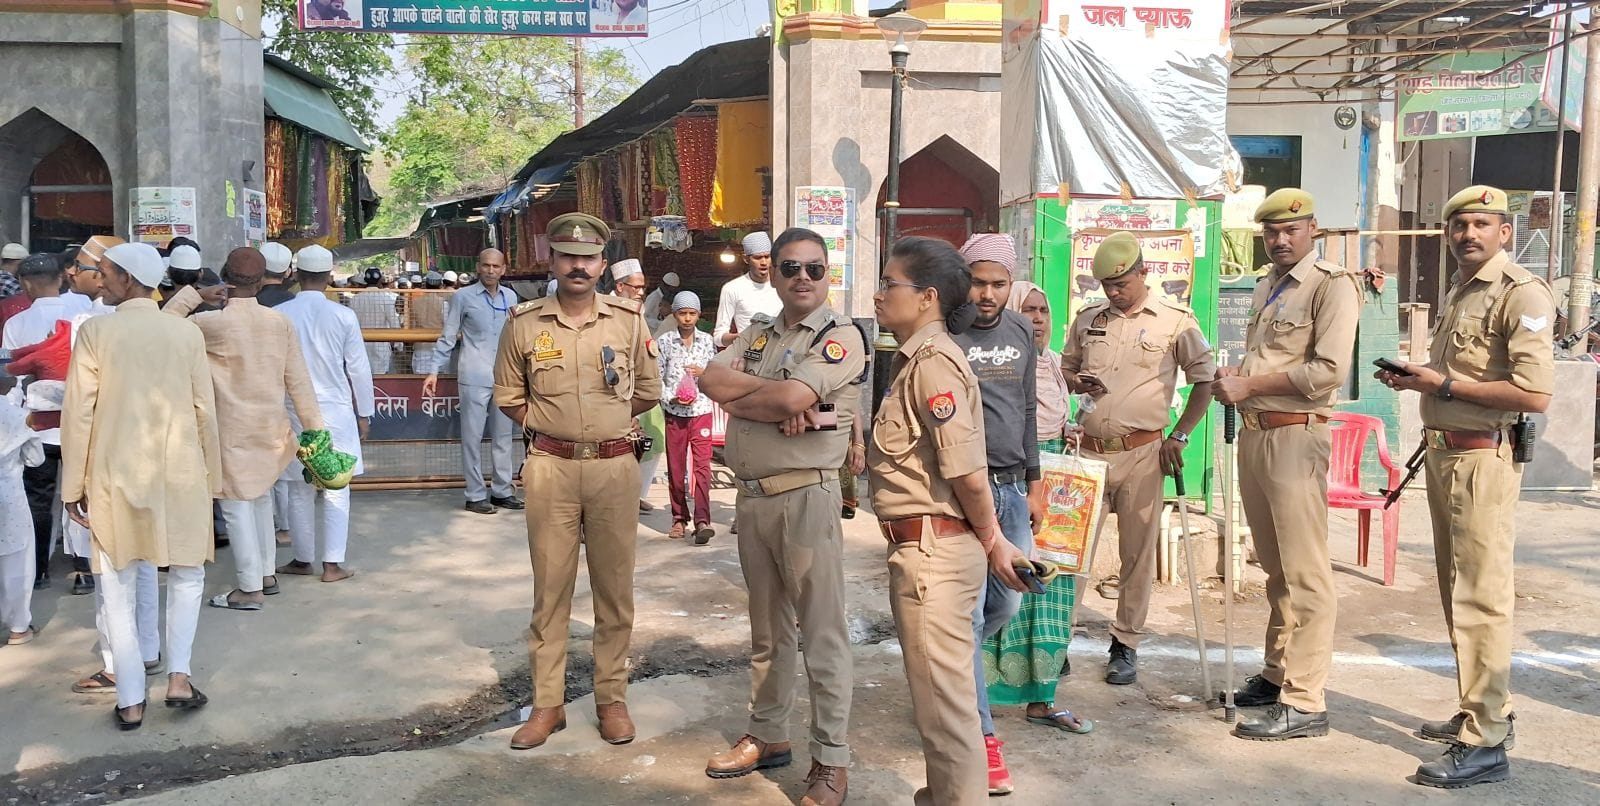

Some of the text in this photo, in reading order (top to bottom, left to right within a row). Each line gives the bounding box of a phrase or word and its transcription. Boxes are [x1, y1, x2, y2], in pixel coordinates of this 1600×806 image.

[392, 4, 418, 24] आपके
[469, 6, 481, 25] की
[484, 6, 498, 25] खैर
[522, 10, 541, 26] करम
[544, 11, 557, 26] हम
[575, 11, 587, 27] पर
[1081, 5, 1193, 29] जल प्याऊ
[1507, 62, 1525, 84] टी
[1149, 239, 1183, 252] अपना
[1172, 258, 1191, 275] करे
